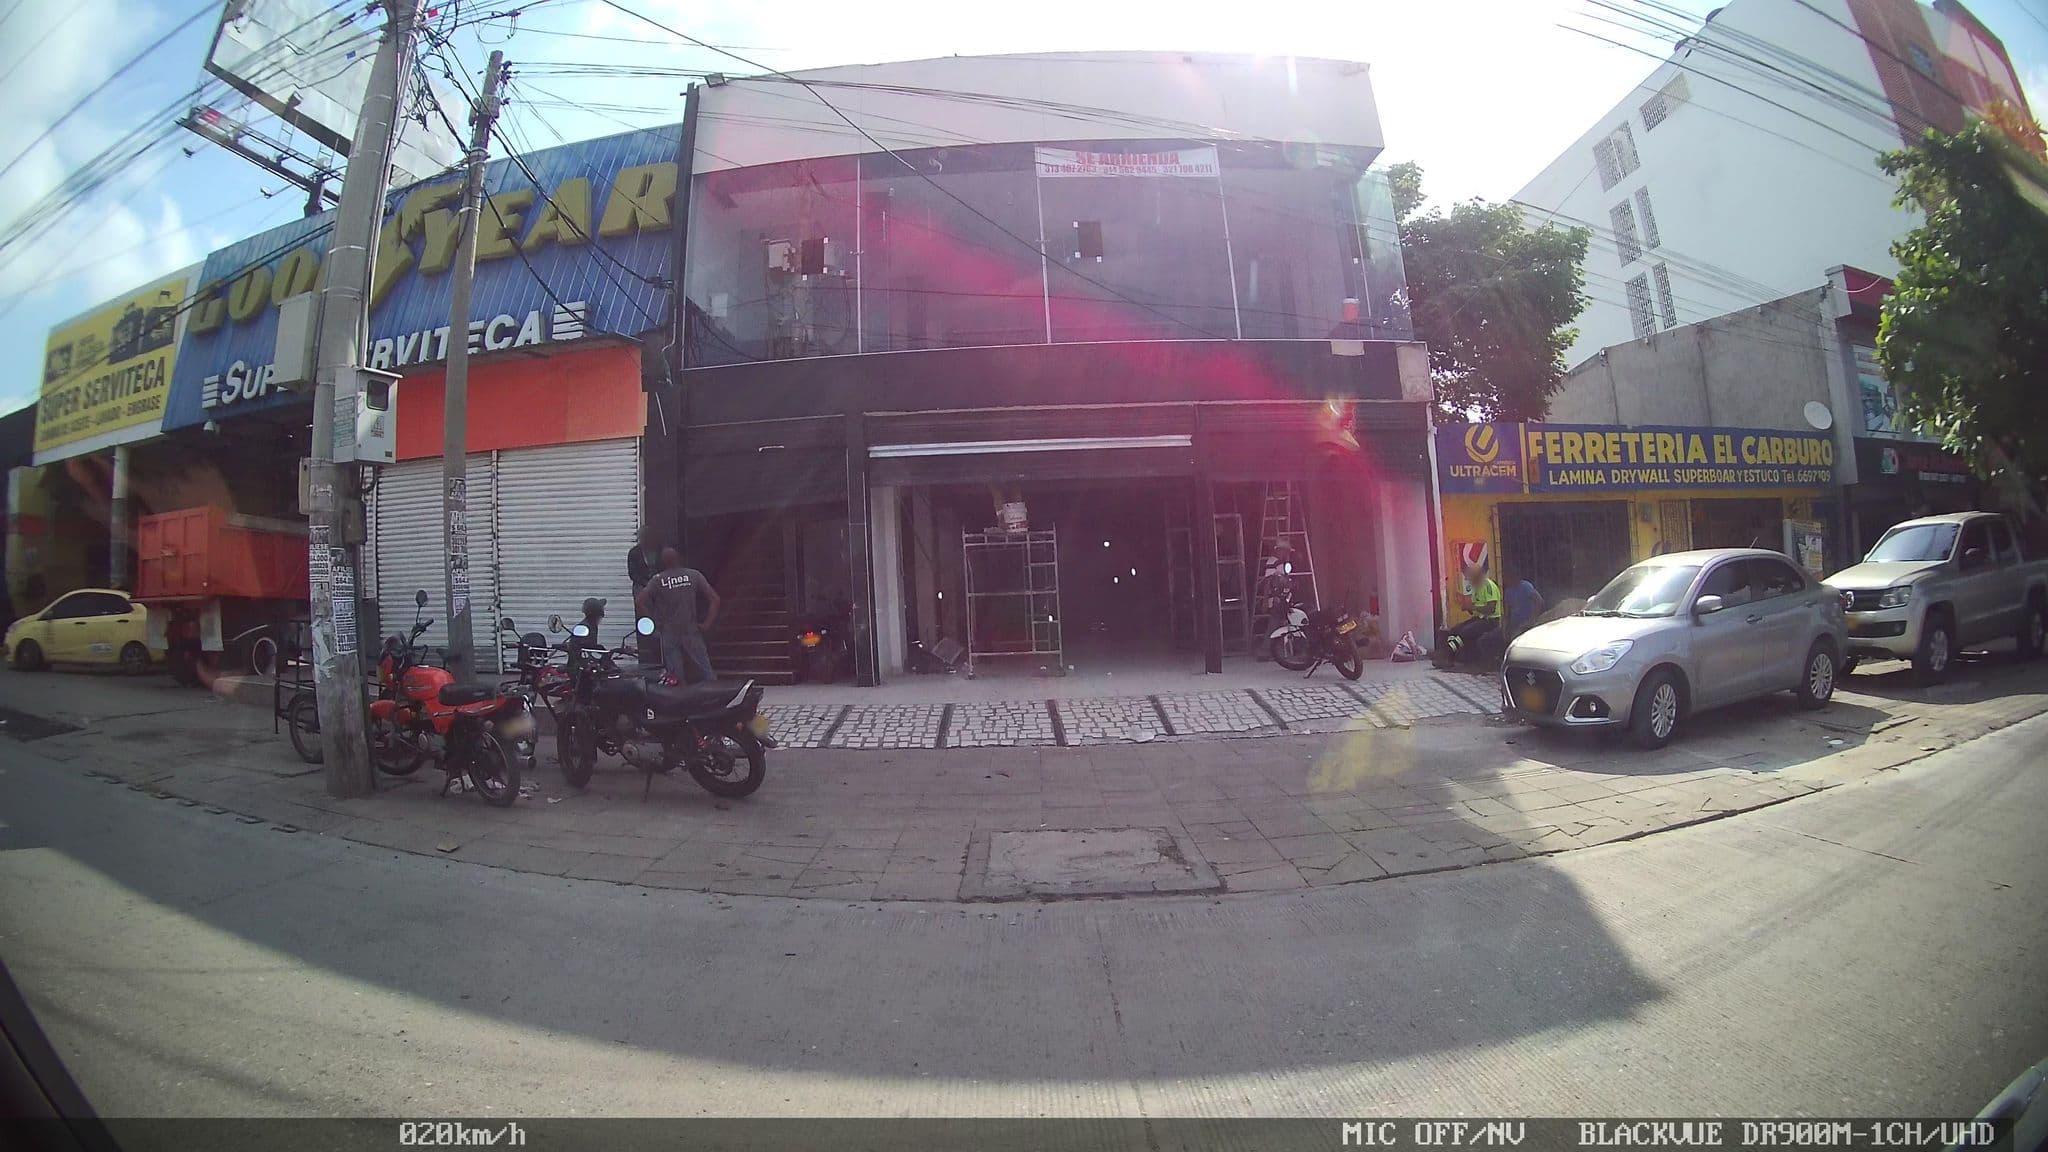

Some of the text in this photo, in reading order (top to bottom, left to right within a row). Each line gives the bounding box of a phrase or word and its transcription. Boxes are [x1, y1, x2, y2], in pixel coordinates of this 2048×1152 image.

[83, 356, 166, 410] SERVITECA
[1528, 431, 1833, 466] FERRETERIA EL CARBURO
[1450, 464, 1517, 477] ULTRACEM
[1549, 470, 1606, 485] LAMINA
[1611, 469, 1670, 484] DRYWALL
